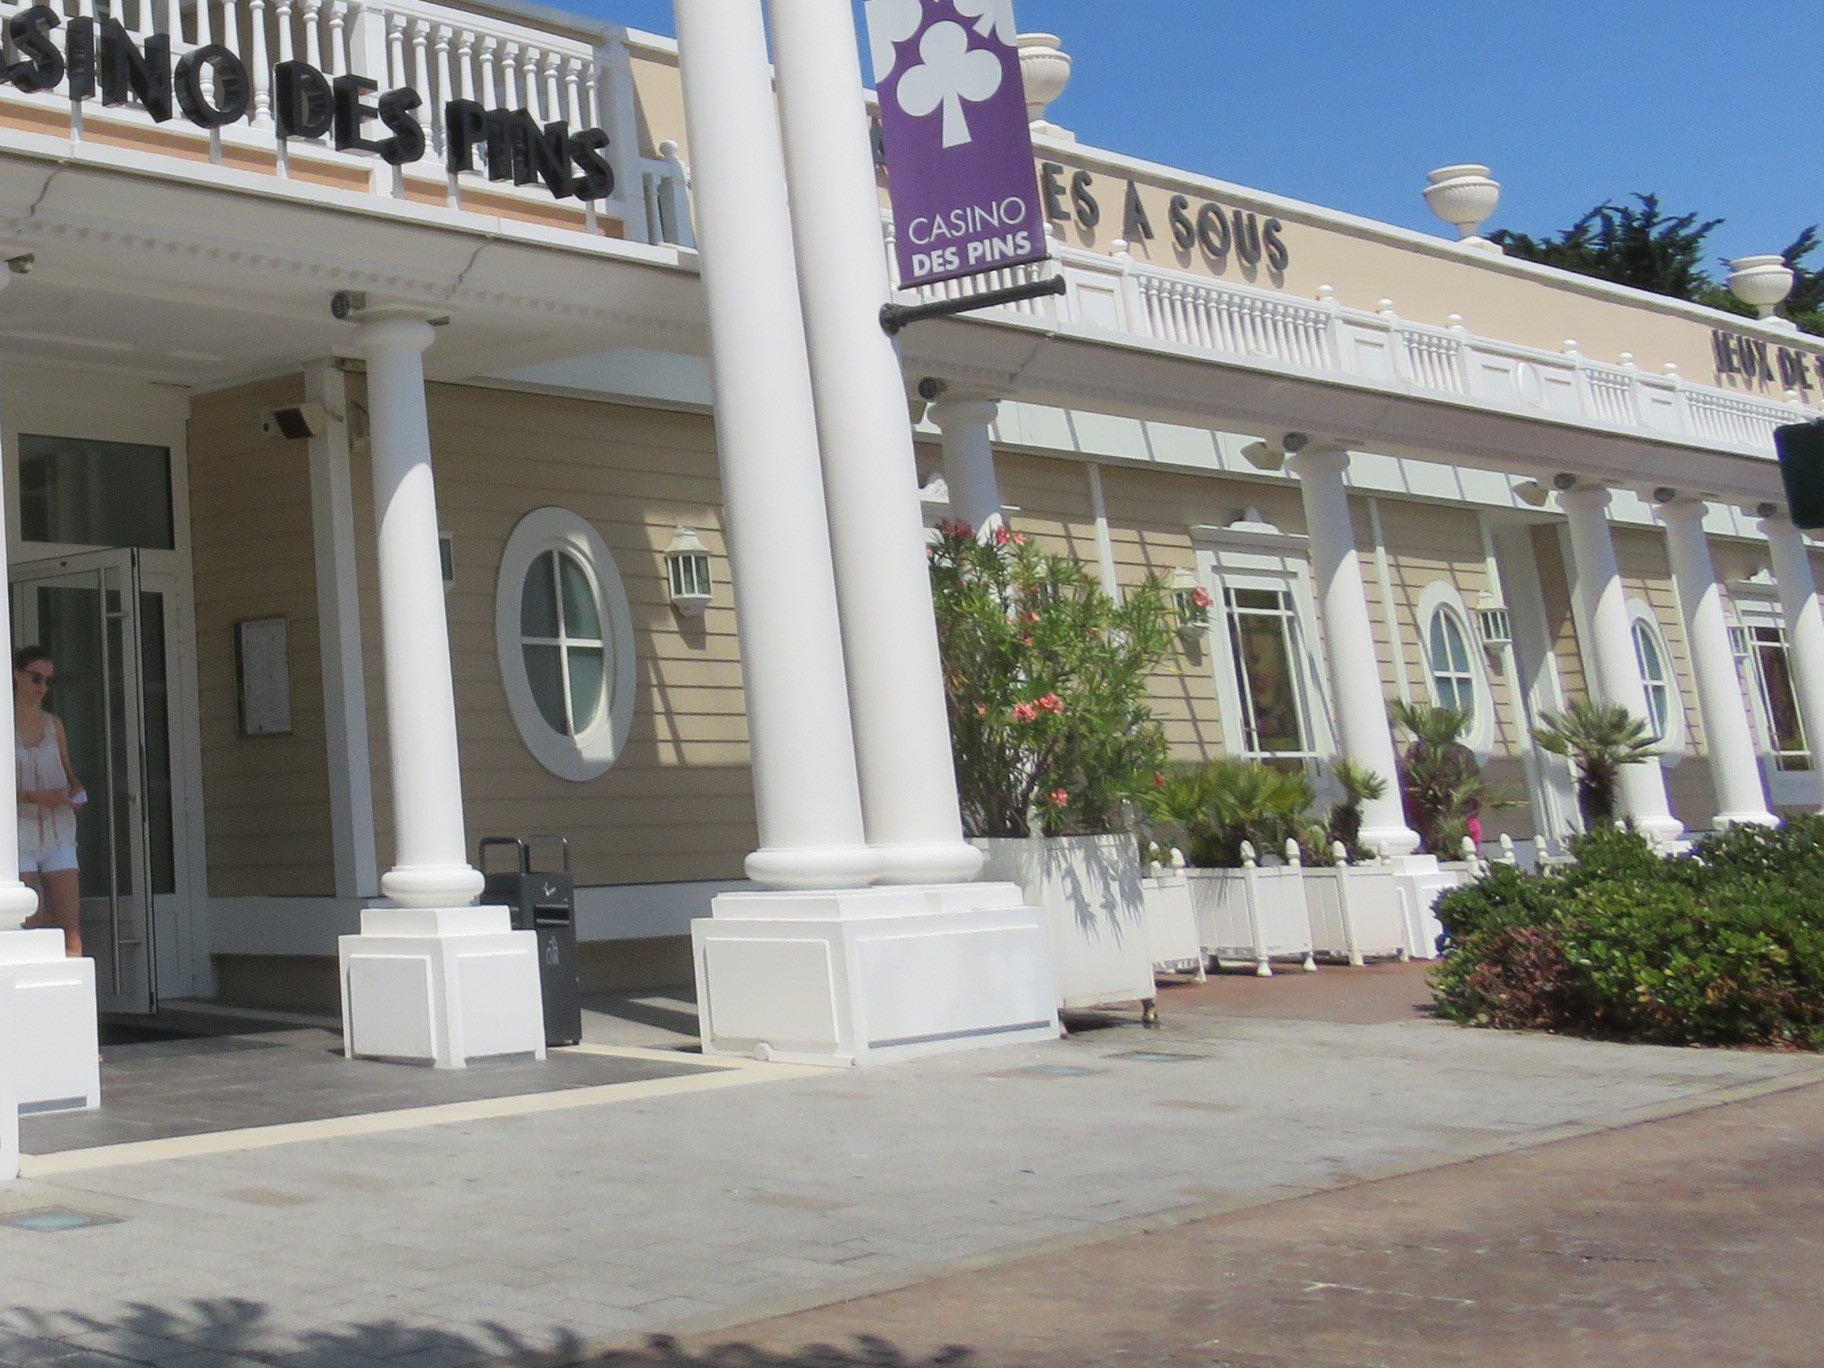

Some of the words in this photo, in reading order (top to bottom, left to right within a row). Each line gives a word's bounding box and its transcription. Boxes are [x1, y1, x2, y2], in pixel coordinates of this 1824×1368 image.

[274, 60, 426, 165] DES
[445, 98, 616, 202] PINS
[908, 196, 1026, 245] CASINO
[912, 246, 960, 277] DES
[967, 230, 1032, 266] PINS
[1124, 180, 1155, 240] A
[1168, 194, 1289, 272] SOUS
